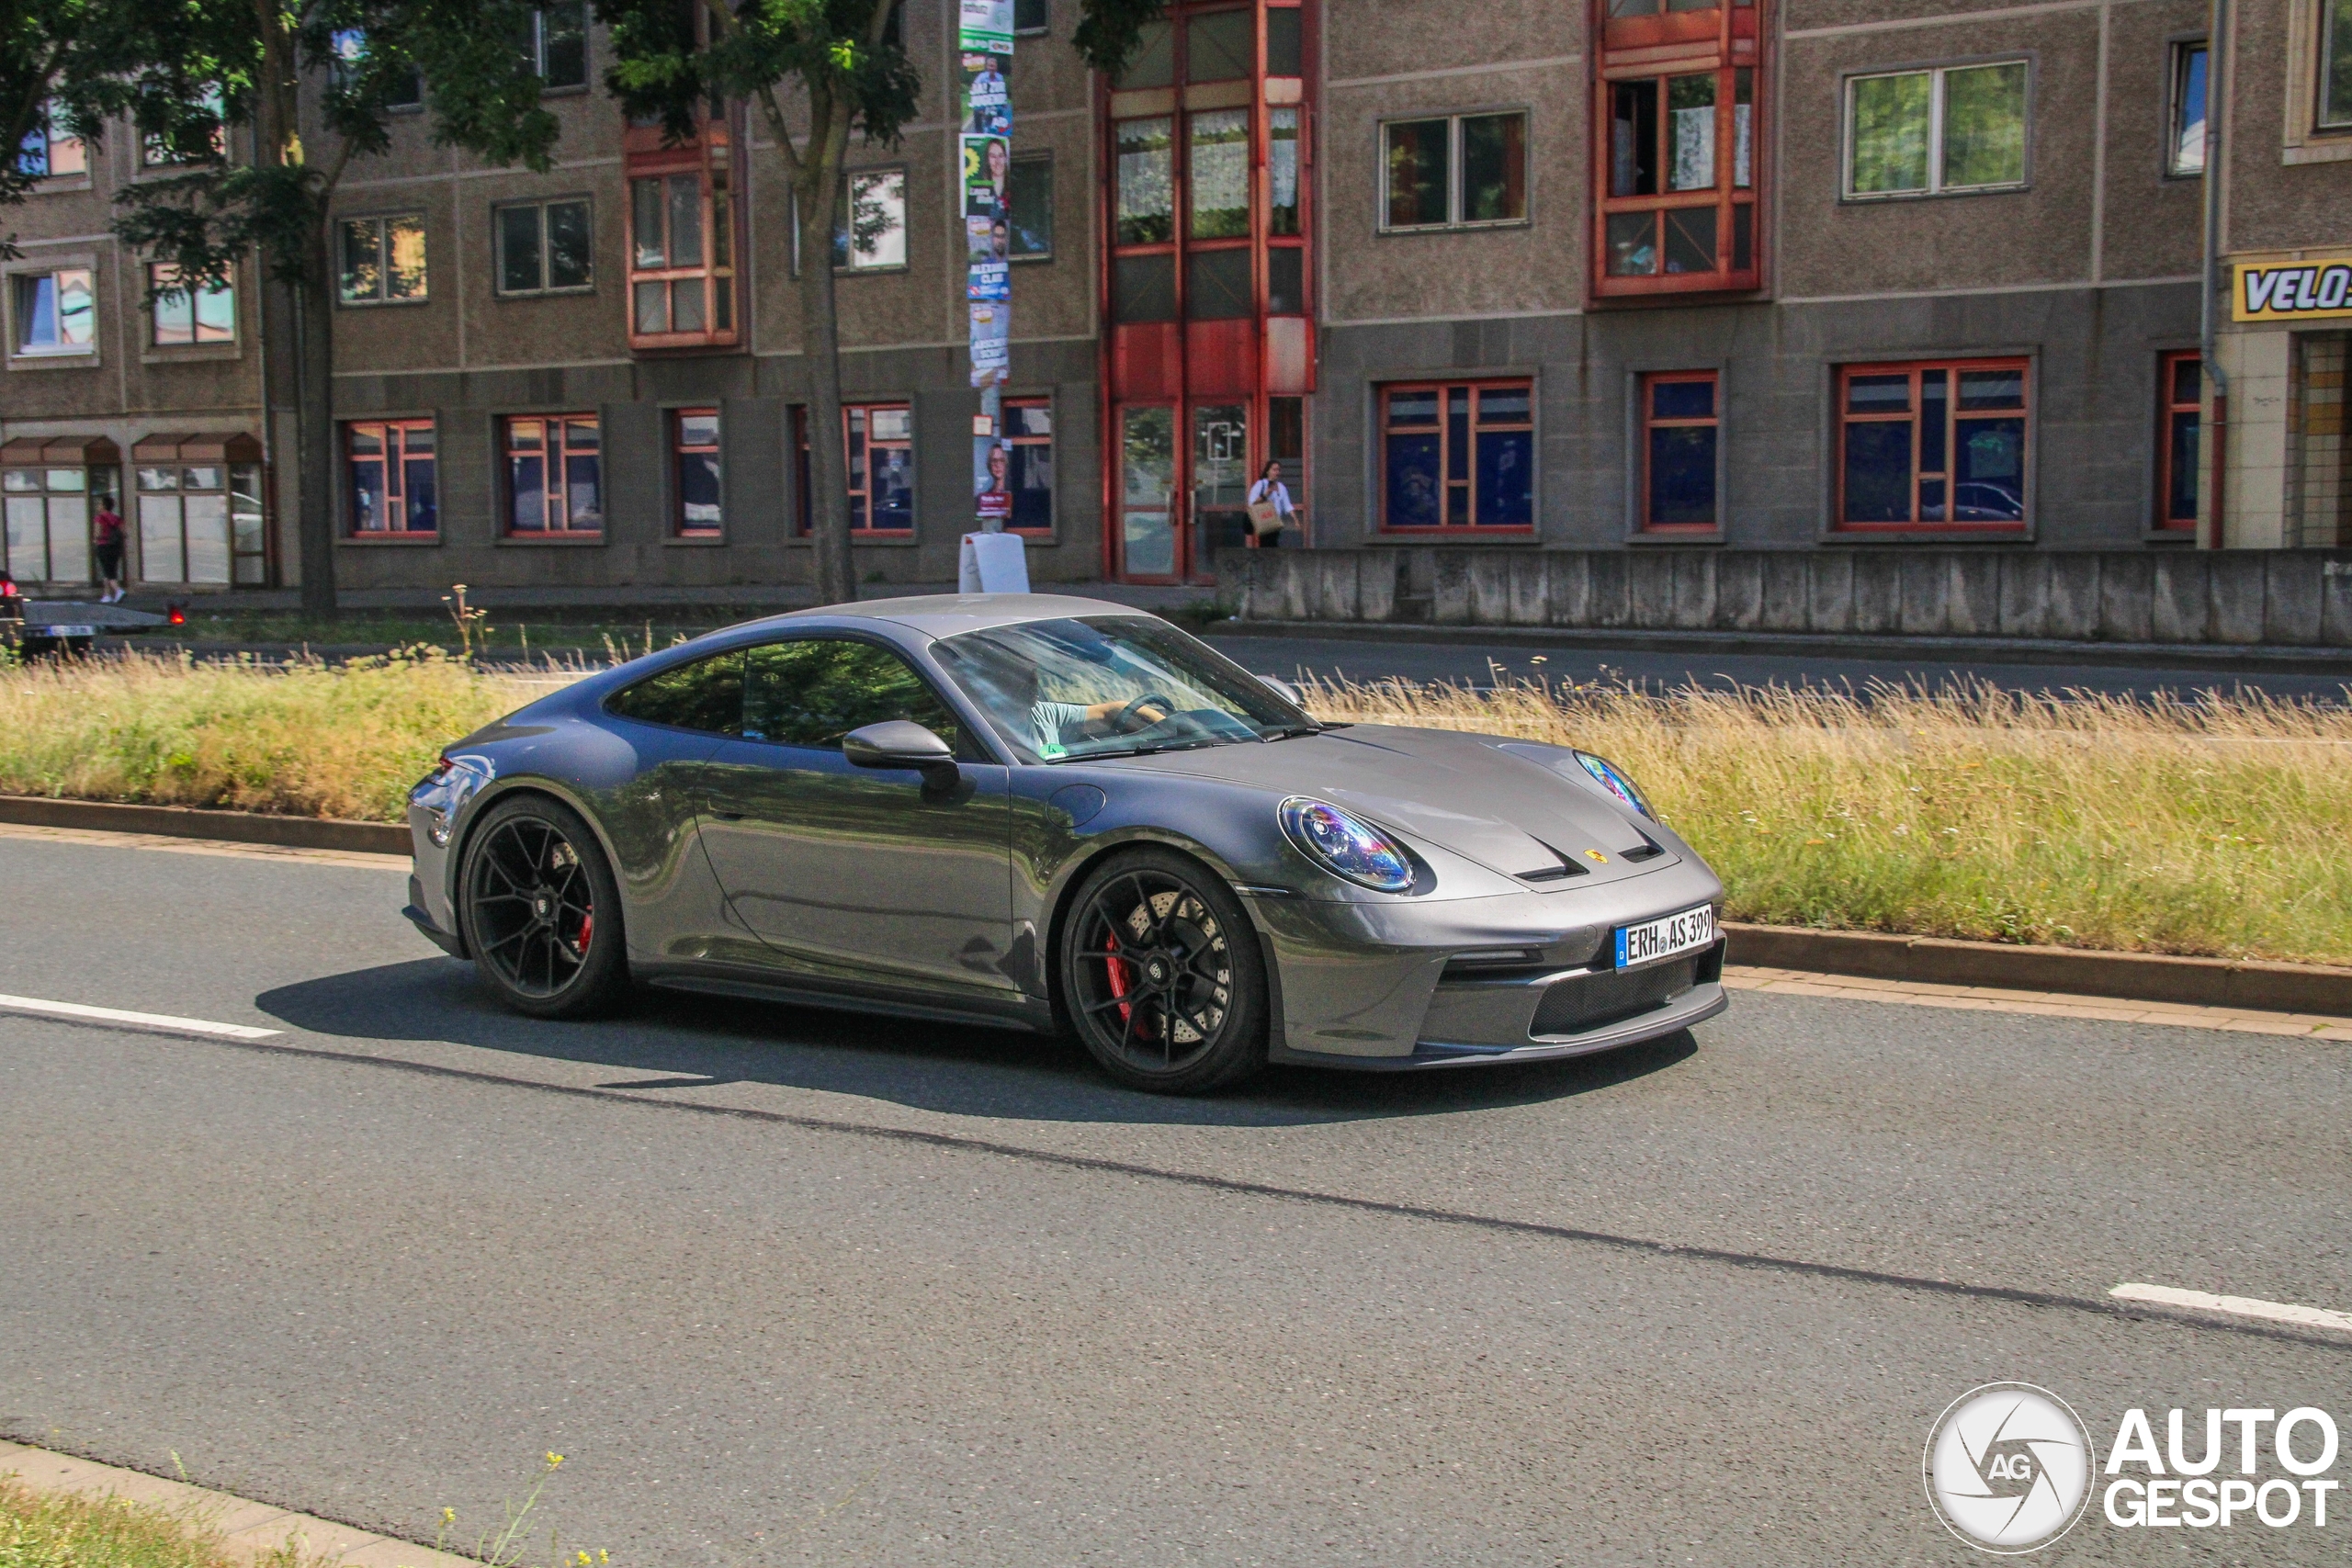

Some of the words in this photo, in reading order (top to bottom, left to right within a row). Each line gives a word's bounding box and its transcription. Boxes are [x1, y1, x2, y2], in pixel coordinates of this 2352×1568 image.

[2245, 265, 2352, 313] VELO
[1619, 951, 1624, 960] D
[1627, 925, 1658, 960] ERH
[1668, 917, 1686, 950] AS
[1689, 908, 1711, 943] 399
